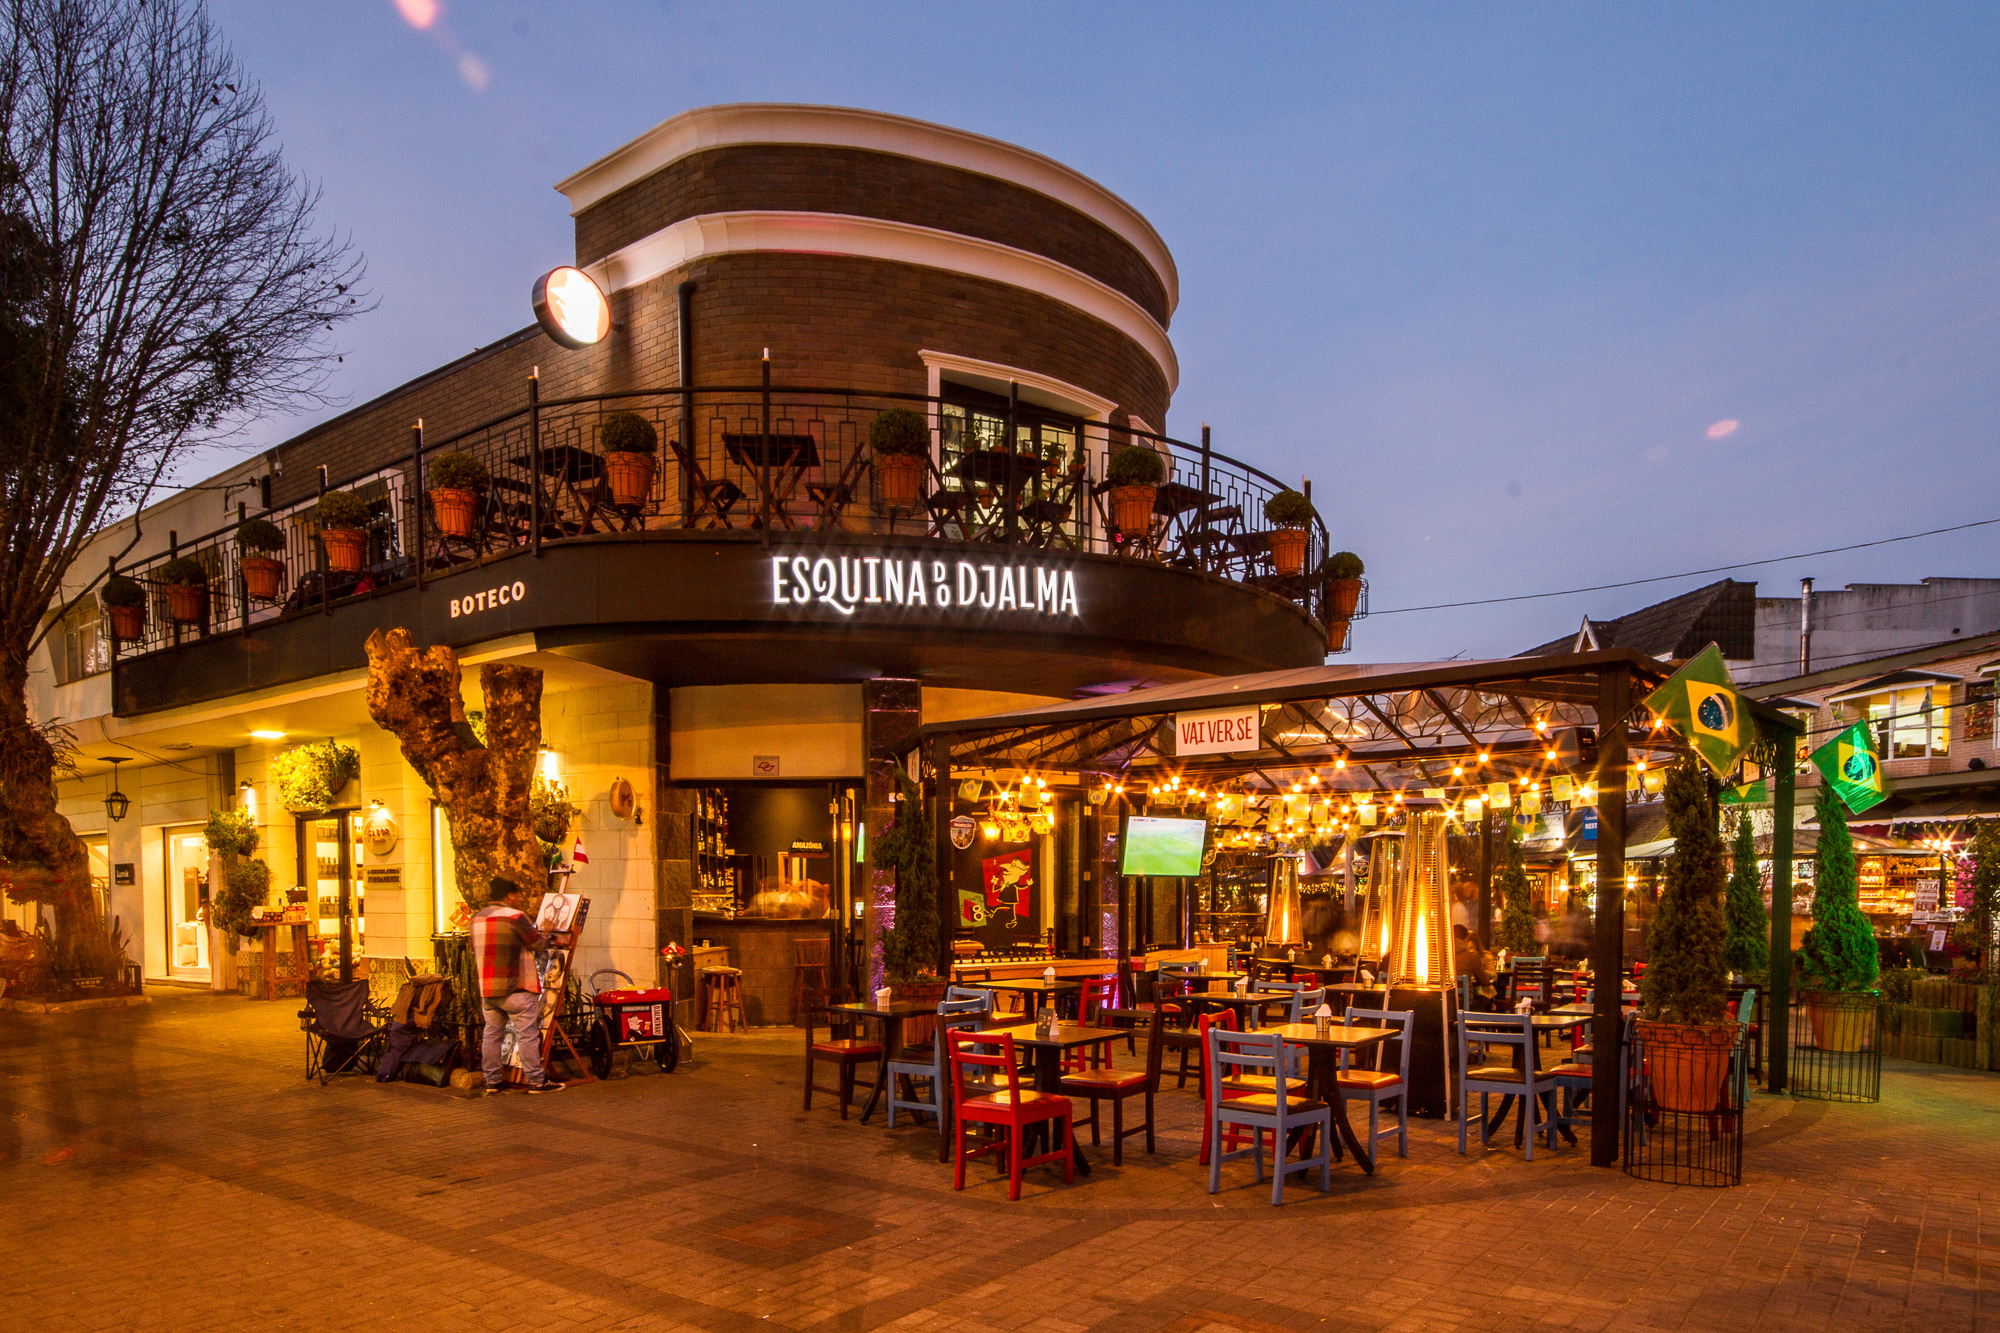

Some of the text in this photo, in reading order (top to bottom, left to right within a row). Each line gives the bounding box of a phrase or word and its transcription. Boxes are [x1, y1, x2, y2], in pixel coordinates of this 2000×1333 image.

[450, 581, 526, 618] BOTECO
[772, 556, 927, 615] ESQUINA
[956, 560, 1080, 616] DJALMA
[1182, 716, 1253, 745] VAI VER SE
